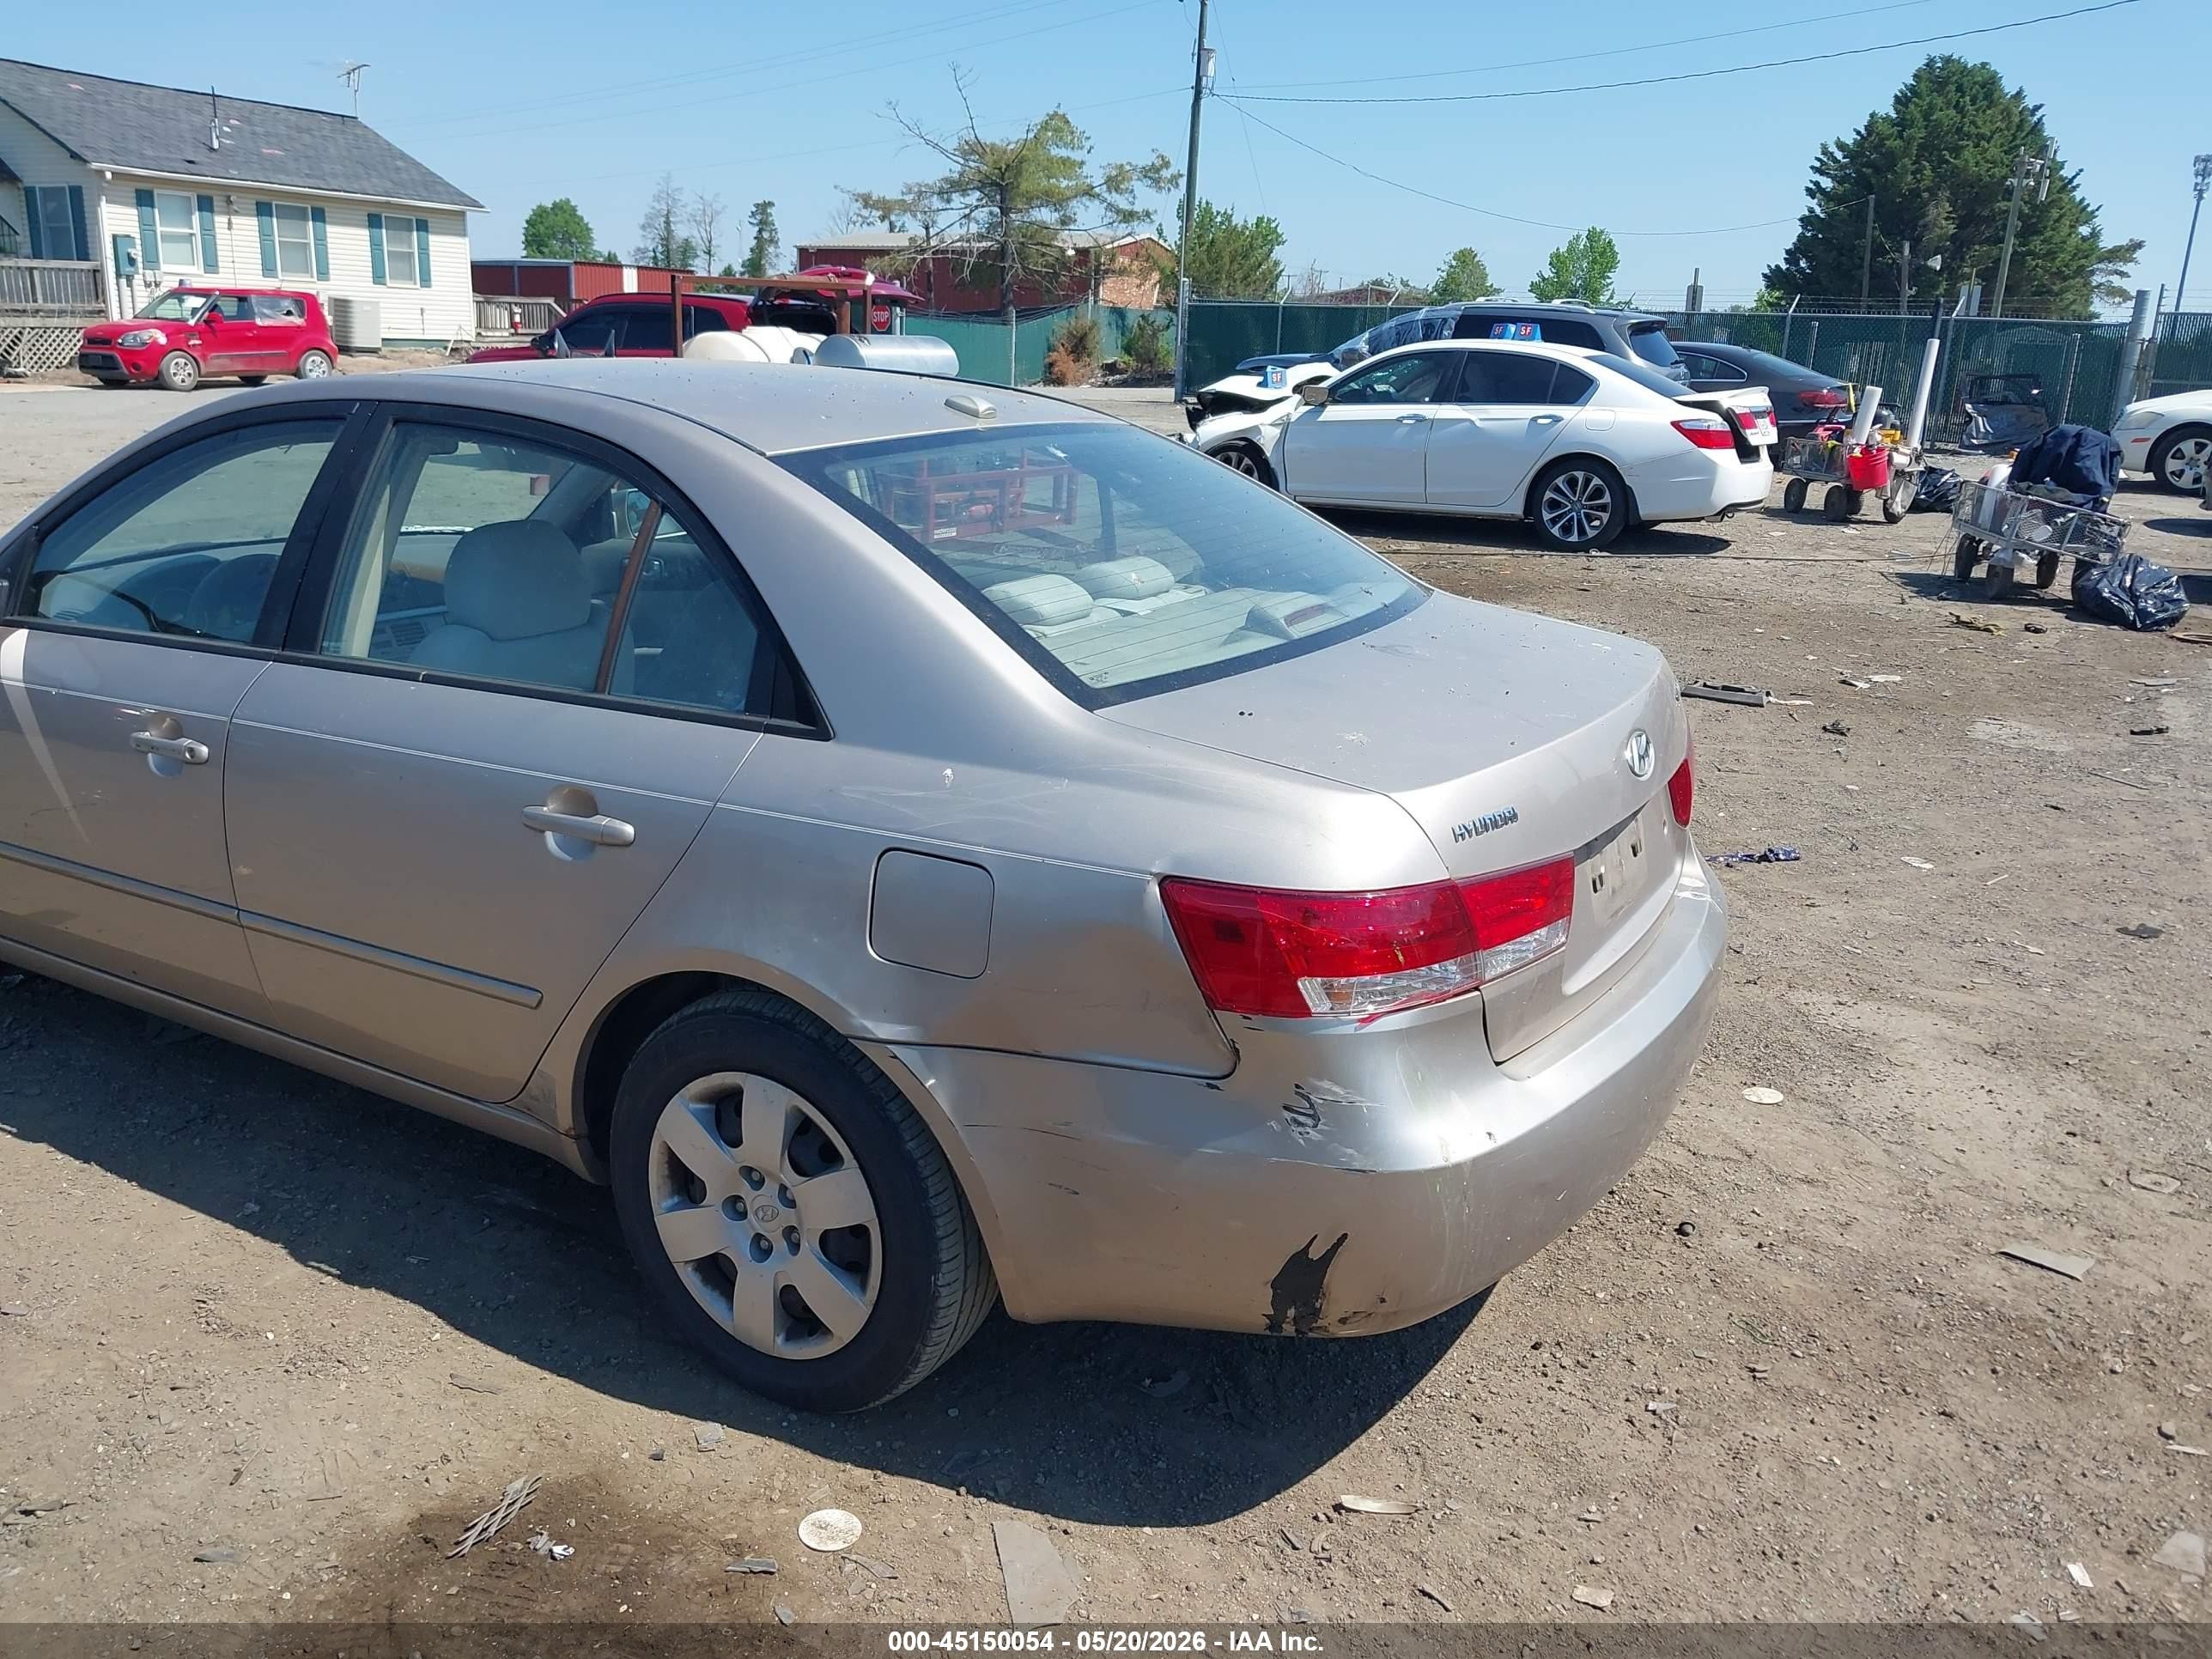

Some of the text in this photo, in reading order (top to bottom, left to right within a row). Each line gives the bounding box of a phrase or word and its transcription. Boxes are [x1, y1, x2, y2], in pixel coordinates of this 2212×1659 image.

[873, 311, 890, 322] STOP
[1494, 326, 1503, 336] SF
[1520, 326, 1532, 336] SF
[1272, 373, 1282, 382] SF
[1451, 805, 1519, 843] HYUNDAI
